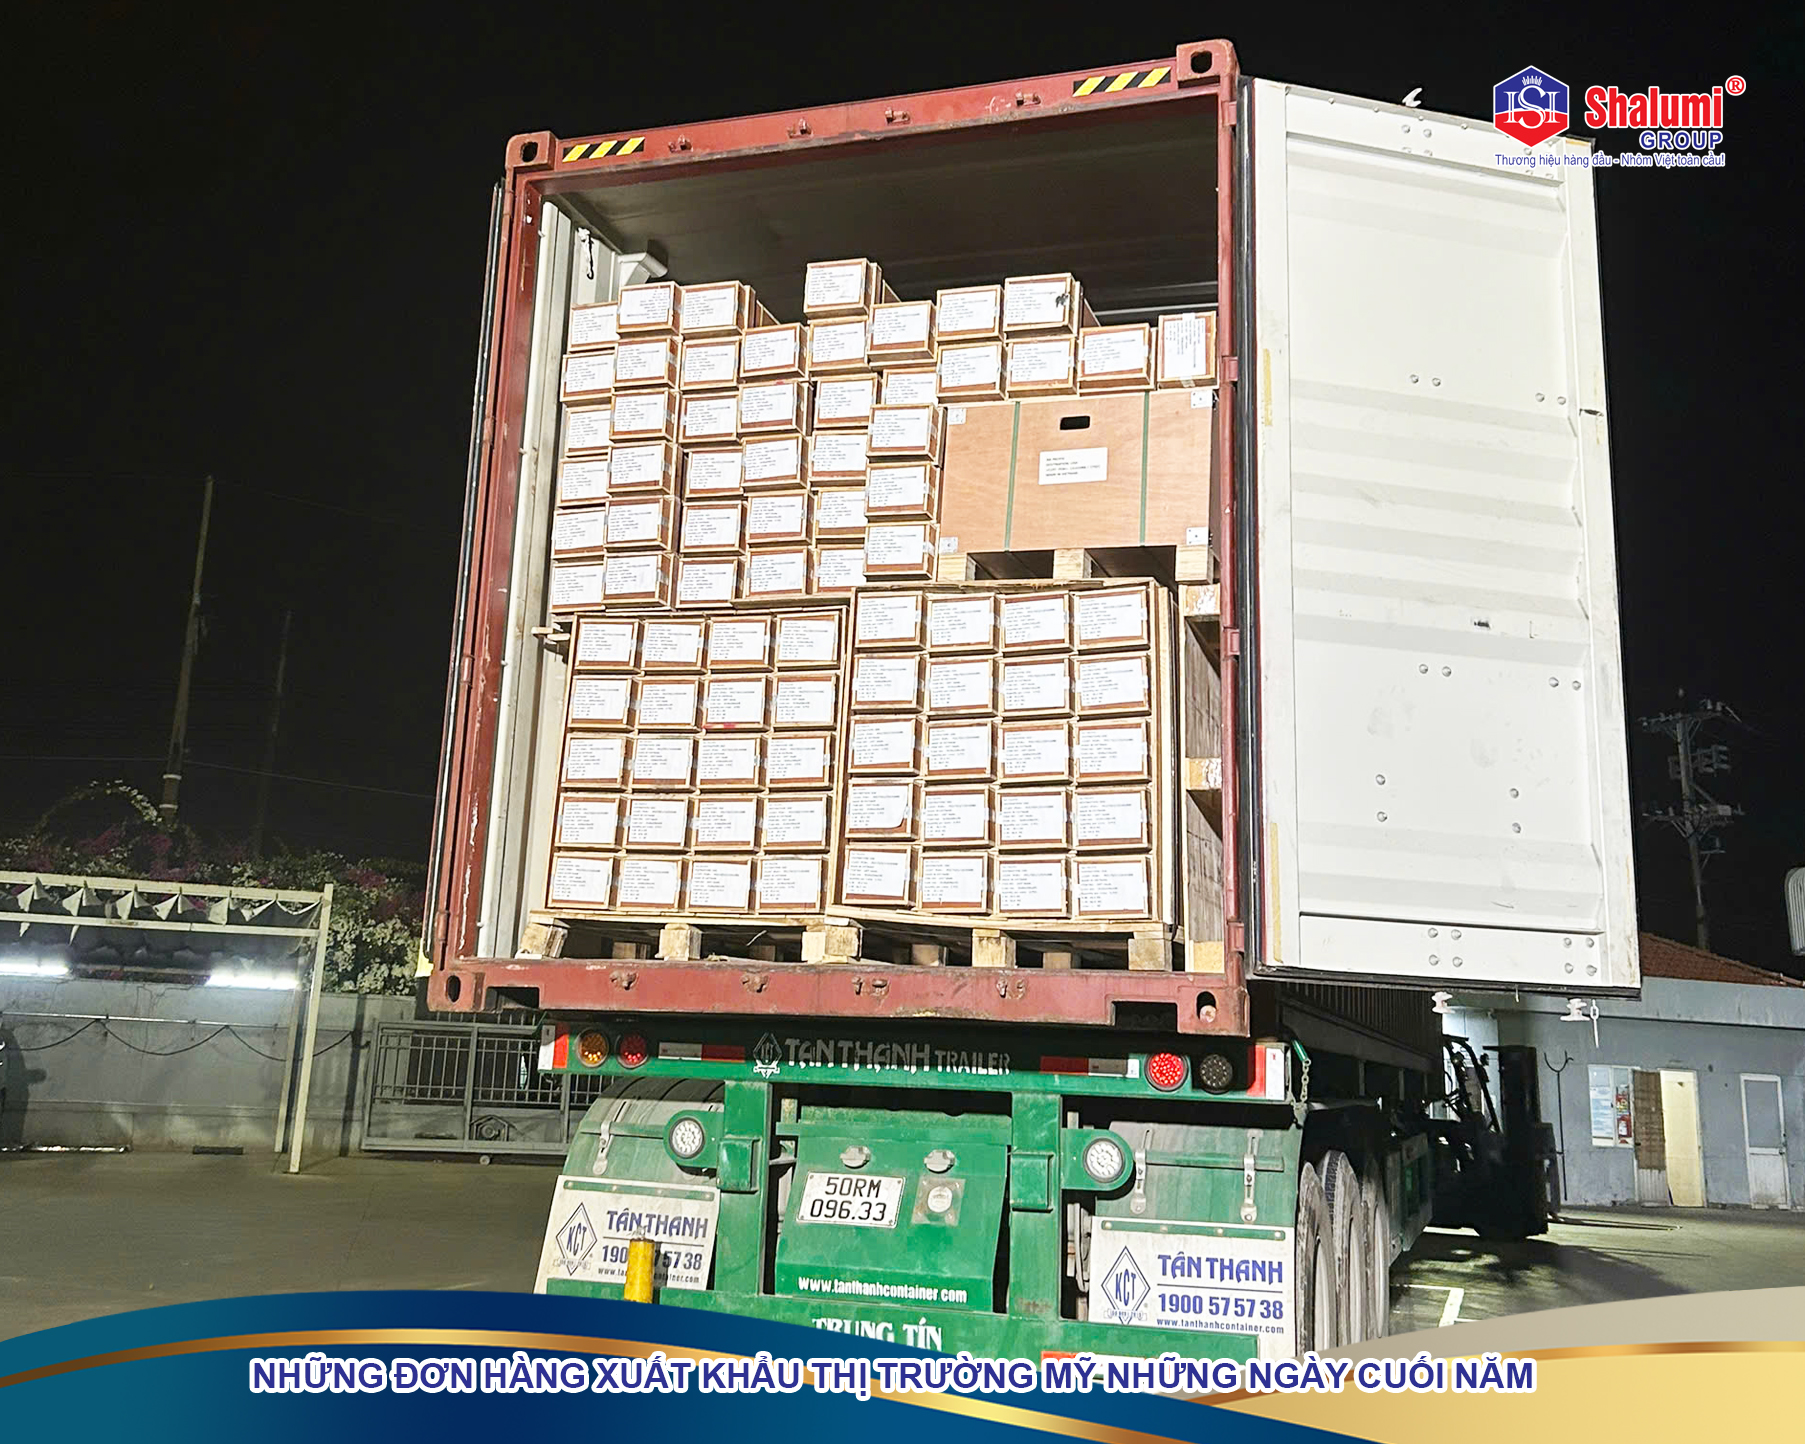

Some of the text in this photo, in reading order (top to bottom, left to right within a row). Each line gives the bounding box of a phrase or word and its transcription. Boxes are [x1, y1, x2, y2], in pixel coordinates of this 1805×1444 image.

[837, 1041, 931, 1074] THANH
[933, 1049, 1011, 1075] TRAILER
[824, 1176, 882, 1198] 50RM
[606, 1207, 709, 1240] TÂN THANH
[809, 1198, 888, 1222] 096.33
[566, 1222, 588, 1256] KCT
[602, 1245, 629, 1265] 190
[1157, 1251, 1283, 1285] TÂN THANH
[798, 1276, 968, 1304] www.tanthanhcontainercom
[1115, 1268, 1137, 1307] KCT
[1158, 1293, 1204, 1314] 1900
[902, 1316, 942, 1352] TÍN
[1156, 1318, 1284, 1334] www.tanthanhcontainer.com
